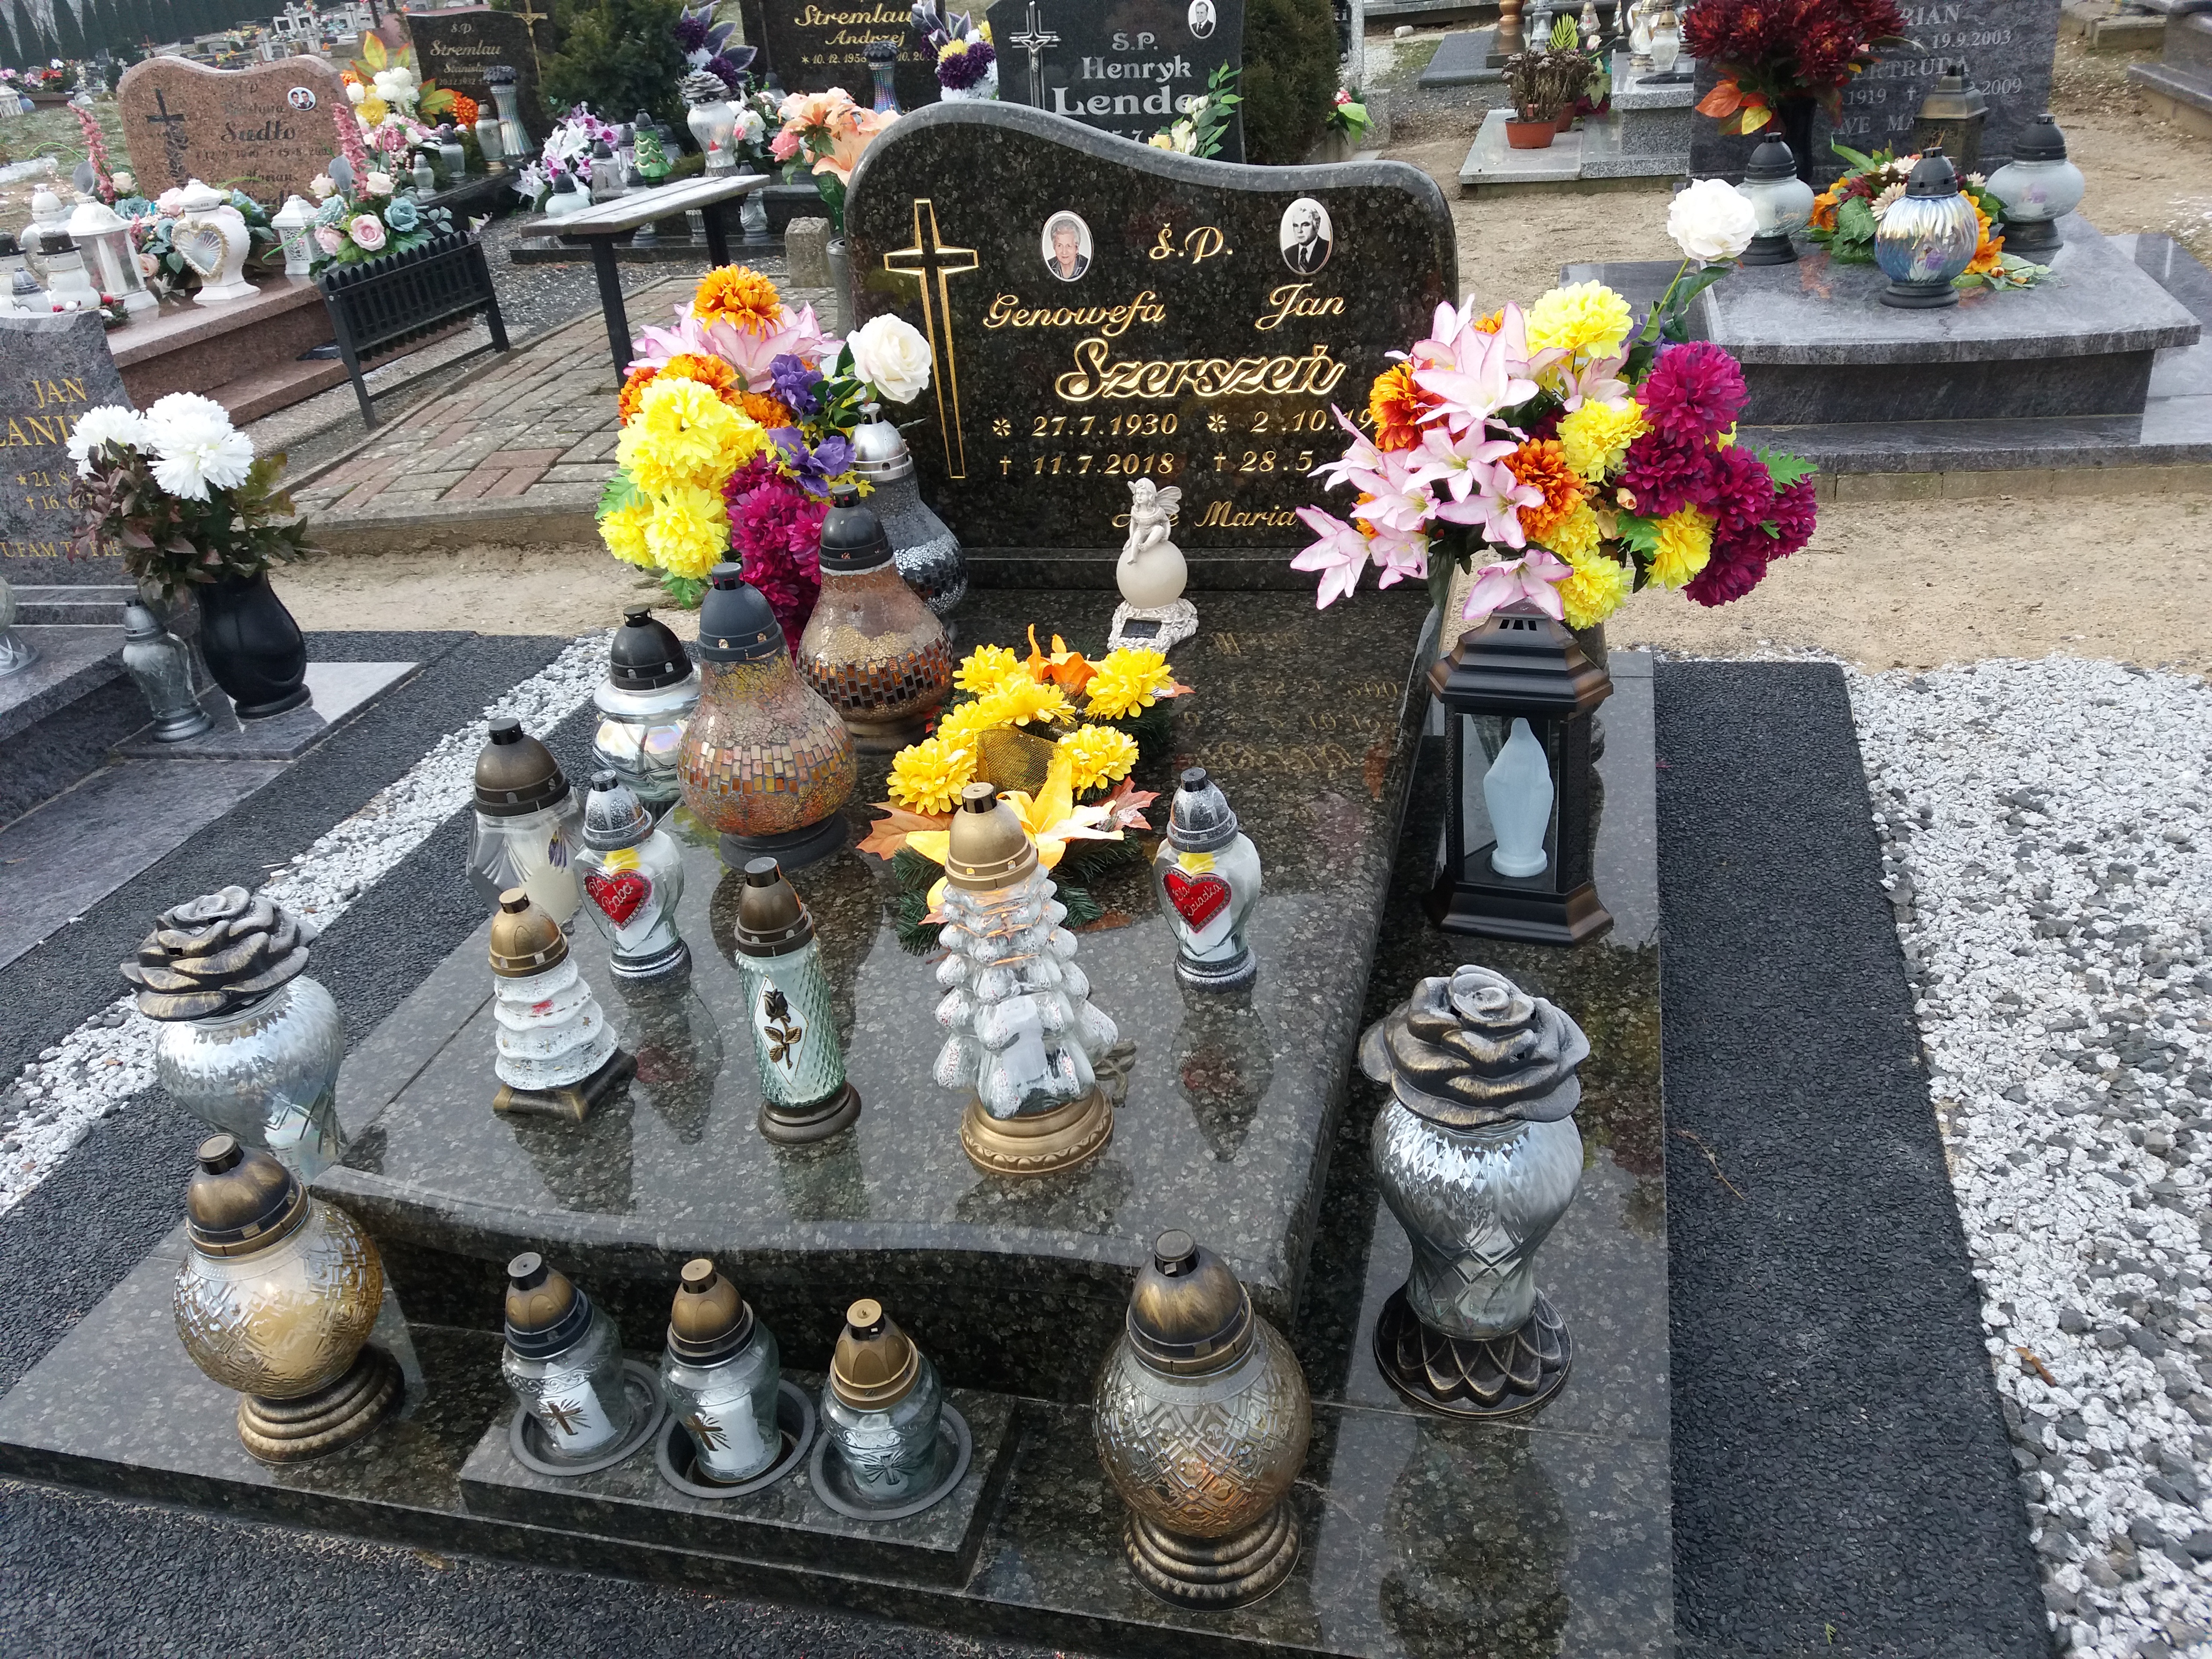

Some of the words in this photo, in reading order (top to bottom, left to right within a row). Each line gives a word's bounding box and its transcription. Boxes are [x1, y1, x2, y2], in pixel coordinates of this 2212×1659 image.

[794, 3, 912, 26] Stremlau
[1900, 3, 1962, 26] RIAN
[430, 39, 502, 56] Stremlau
[825, 29, 906, 47] Andrzej
[1932, 29, 2011, 49] 19.9.2003
[1081, 55, 1192, 83] Henryk
[1051, 85, 1199, 115] Lende
[1886, 114, 1915, 131] MA
[983, 290, 1166, 337] Genowefa
[1255, 283, 1346, 330] Jan
[1055, 337, 1346, 401] Szerszeń
[31, 378, 87, 408] JAN
[1031, 413, 1178, 436] 27.7.1930
[1033, 453, 1174, 475] 11.7.2018
[1239, 450, 1313, 472] 28.5
[1194, 500, 1297, 527] Maria
[0, 541, 58, 557] UFAM
[589, 878, 607, 897] Dla
[1184, 884, 1222, 916] Dziadka
